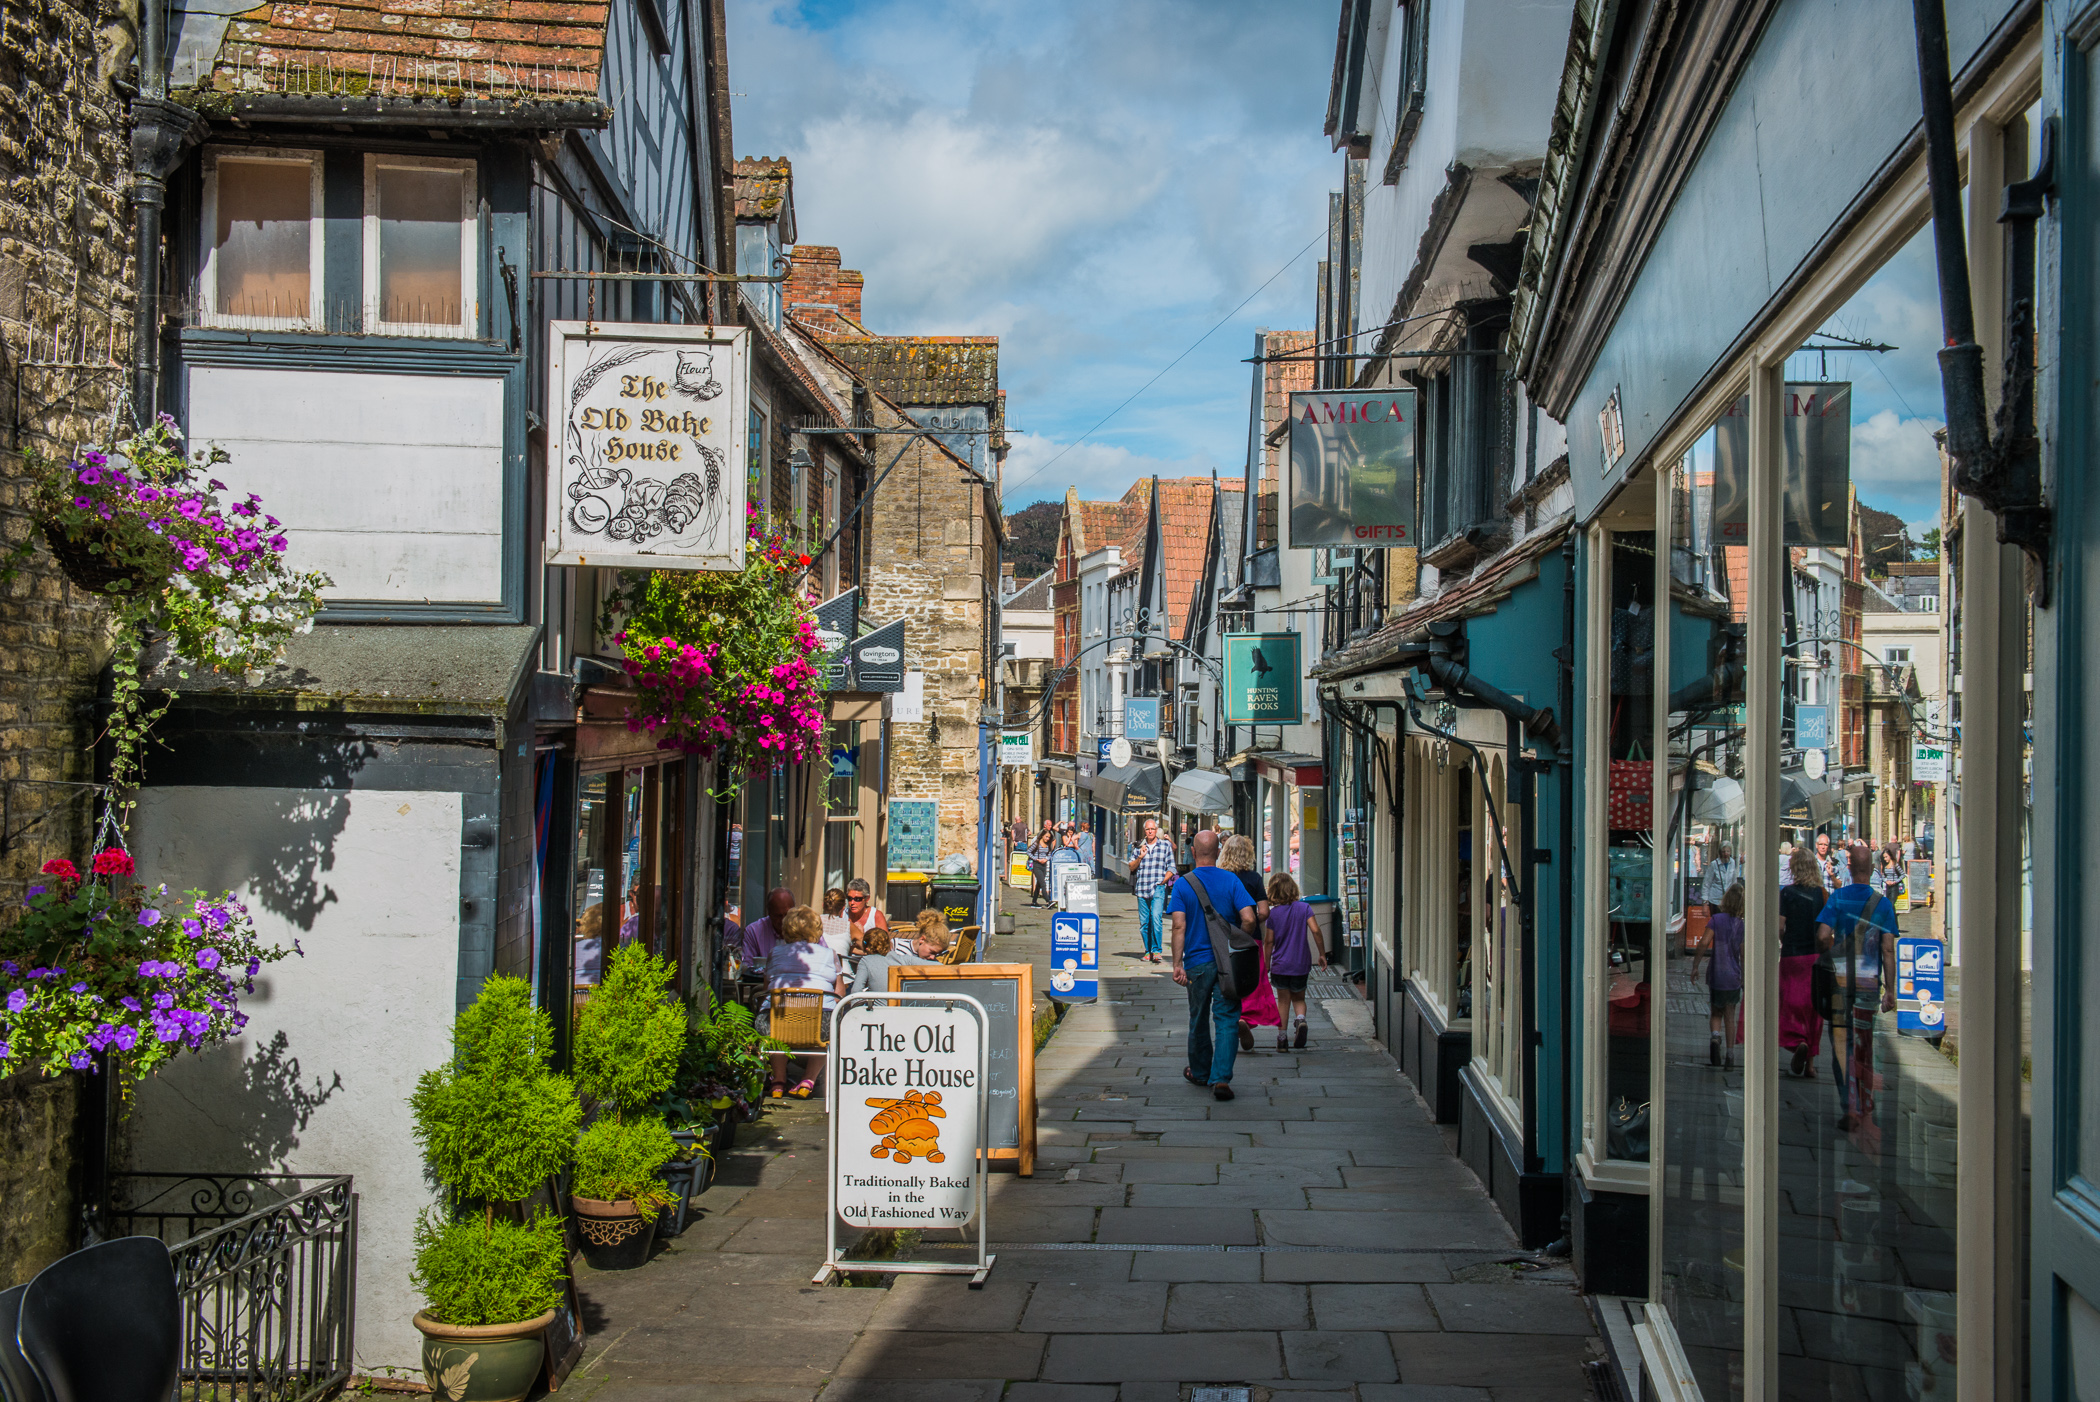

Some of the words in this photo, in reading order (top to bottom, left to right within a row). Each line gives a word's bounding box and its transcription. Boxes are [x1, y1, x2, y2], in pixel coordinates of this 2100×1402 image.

[680, 362, 709, 375] Flour
[620, 374, 669, 403] The
[1299, 400, 1406, 425] AMICA
[580, 406, 632, 432] Old
[640, 409, 712, 440] Bake
[602, 436, 683, 463] House
[1355, 525, 1406, 539] GIFTS
[863, 650, 896, 658] lovingtons
[1247, 694, 1278, 702] RAVEN
[1128, 707, 1151, 717] Rose
[1247, 702, 1279, 710] BOOKS
[1133, 713, 1146, 724] &
[1128, 720, 1155, 731] Lyons
[1067, 883, 1091, 892] Come
[1067, 892, 1096, 900] Browse
[861, 1023, 906, 1053] The
[913, 1024, 956, 1054] Old
[840, 1056, 898, 1087] Bake
[904, 1058, 975, 1088] House
[843, 1175, 926, 1190] Traditionally
[929, 1176, 970, 1189] Baked
[888, 1192, 901, 1203] in
[904, 1192, 925, 1203] the
[843, 1205, 867, 1218] Old
[871, 1206, 935, 1219] Fashioned
[939, 1207, 969, 1222] Way
